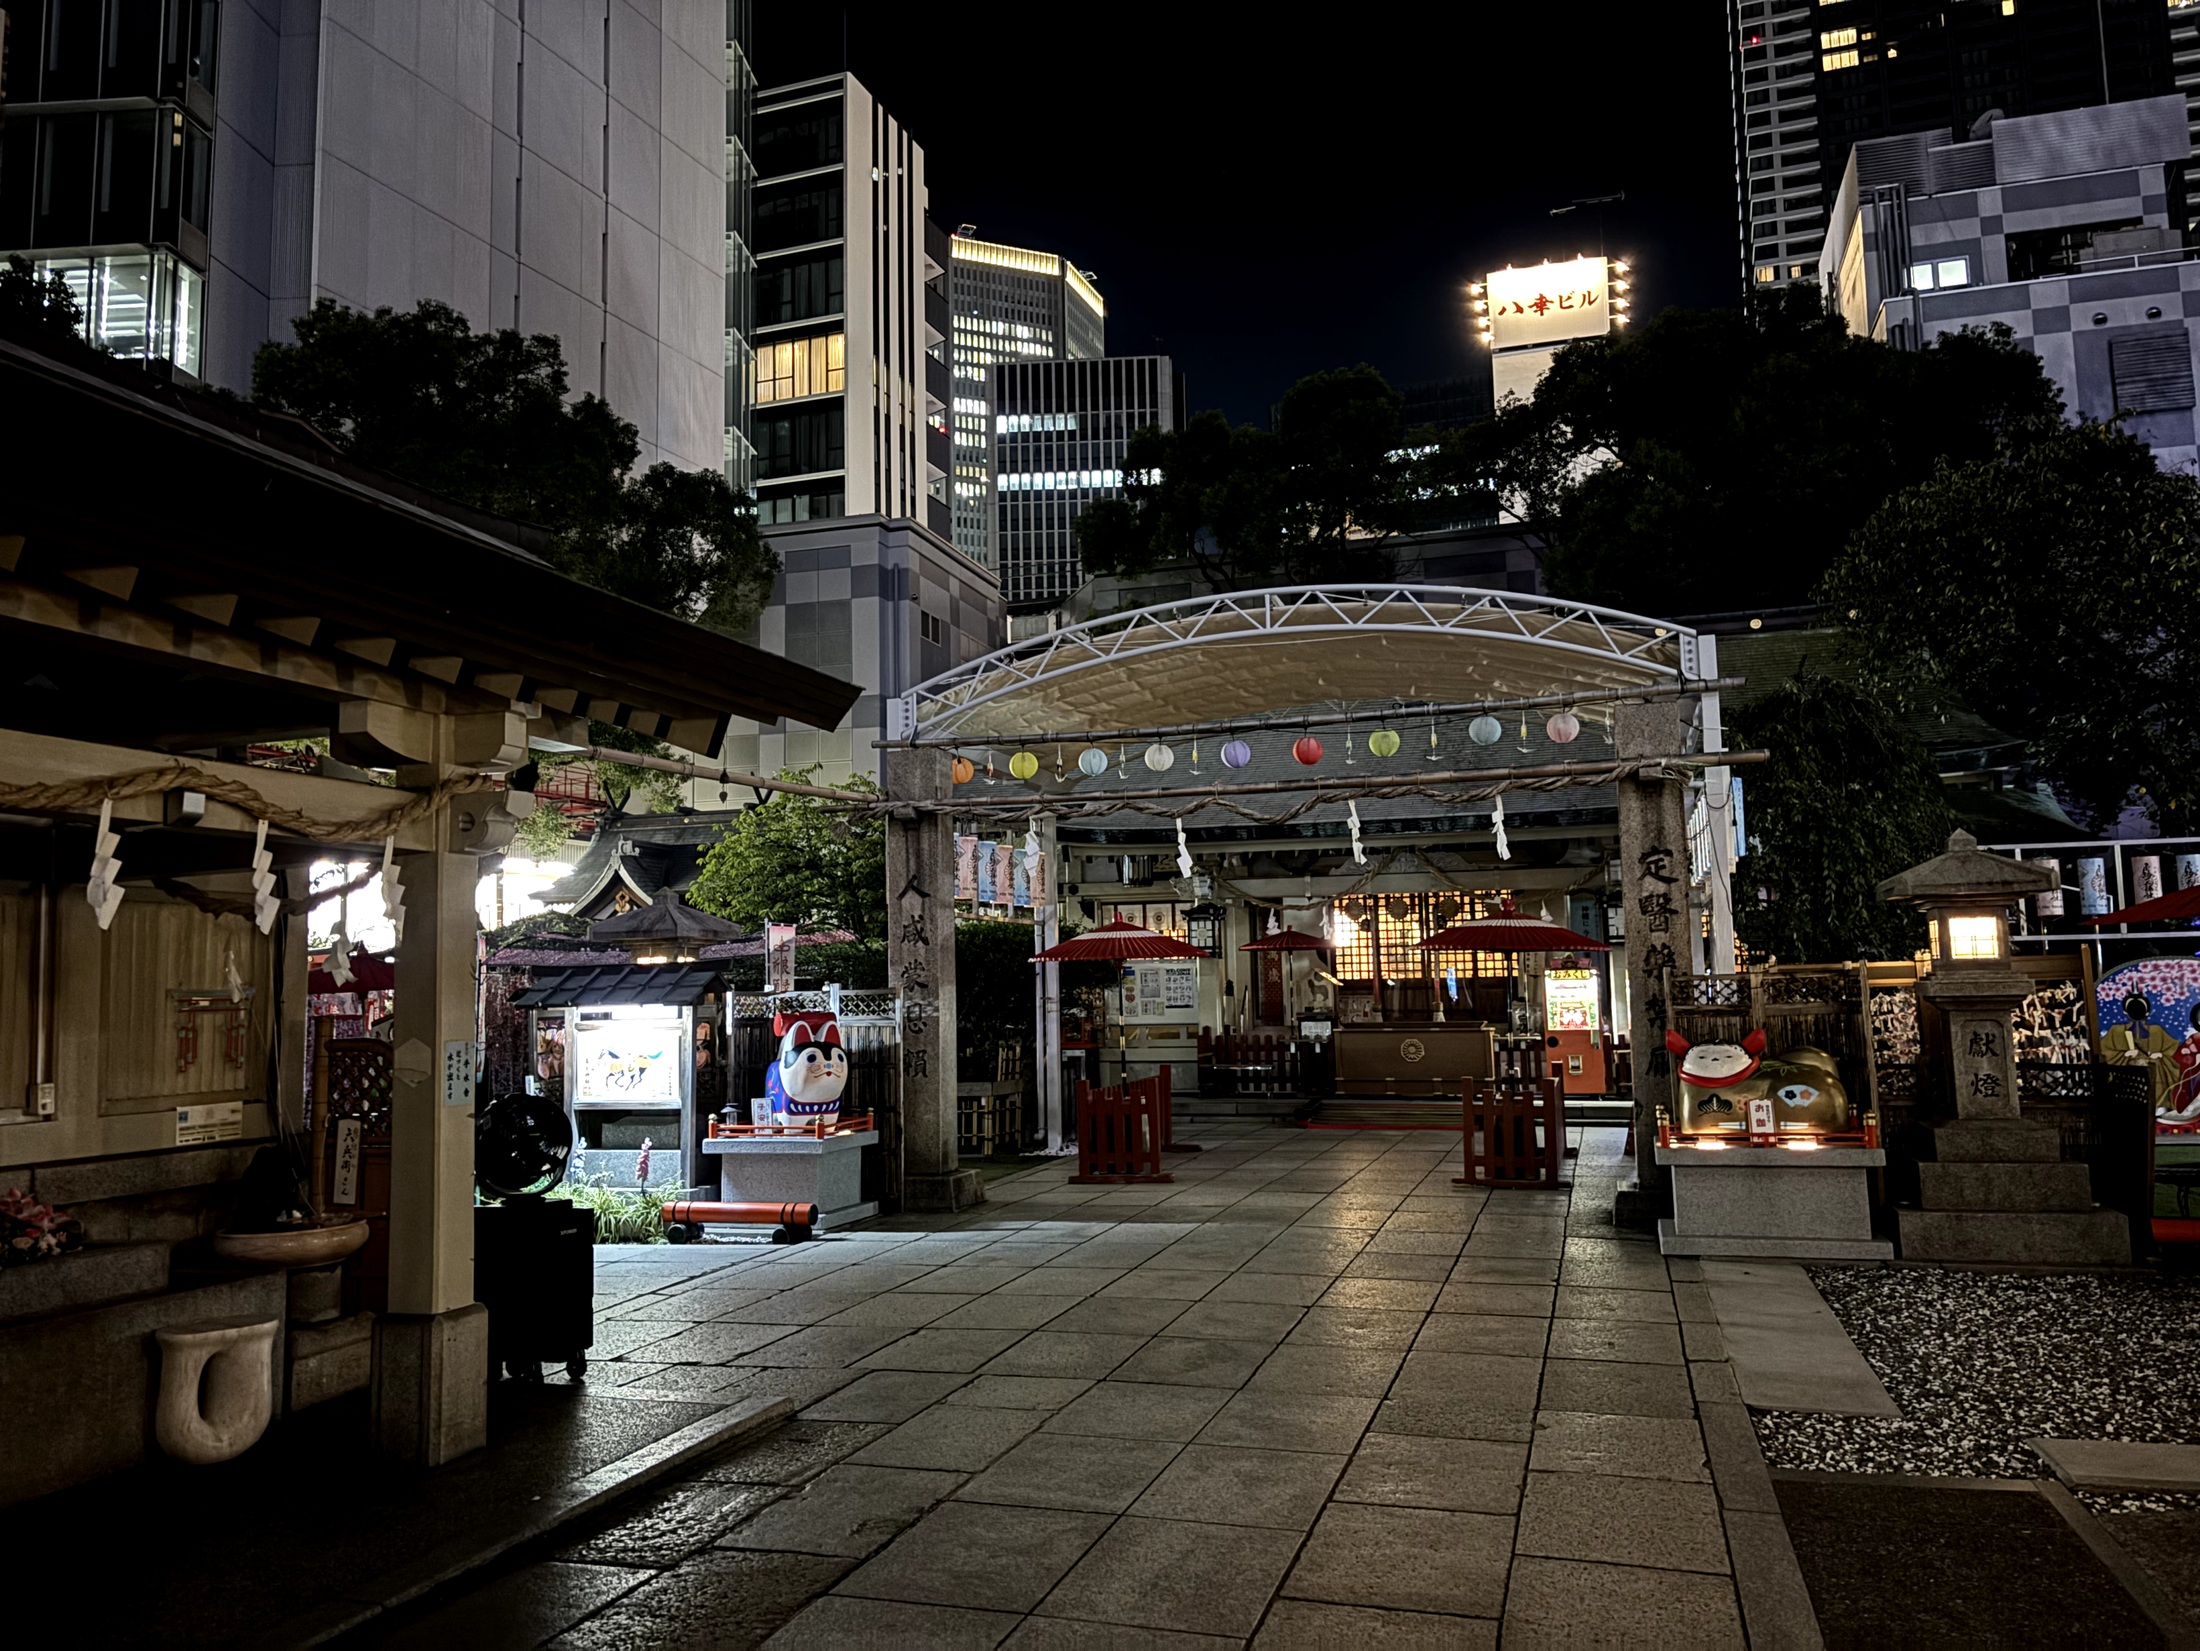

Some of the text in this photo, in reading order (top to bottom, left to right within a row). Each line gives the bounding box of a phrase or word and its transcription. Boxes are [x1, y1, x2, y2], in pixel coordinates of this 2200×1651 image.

[1497, 290, 1600, 317] 八幸ビル
[1553, 970, 1587, 979] おみくじ
